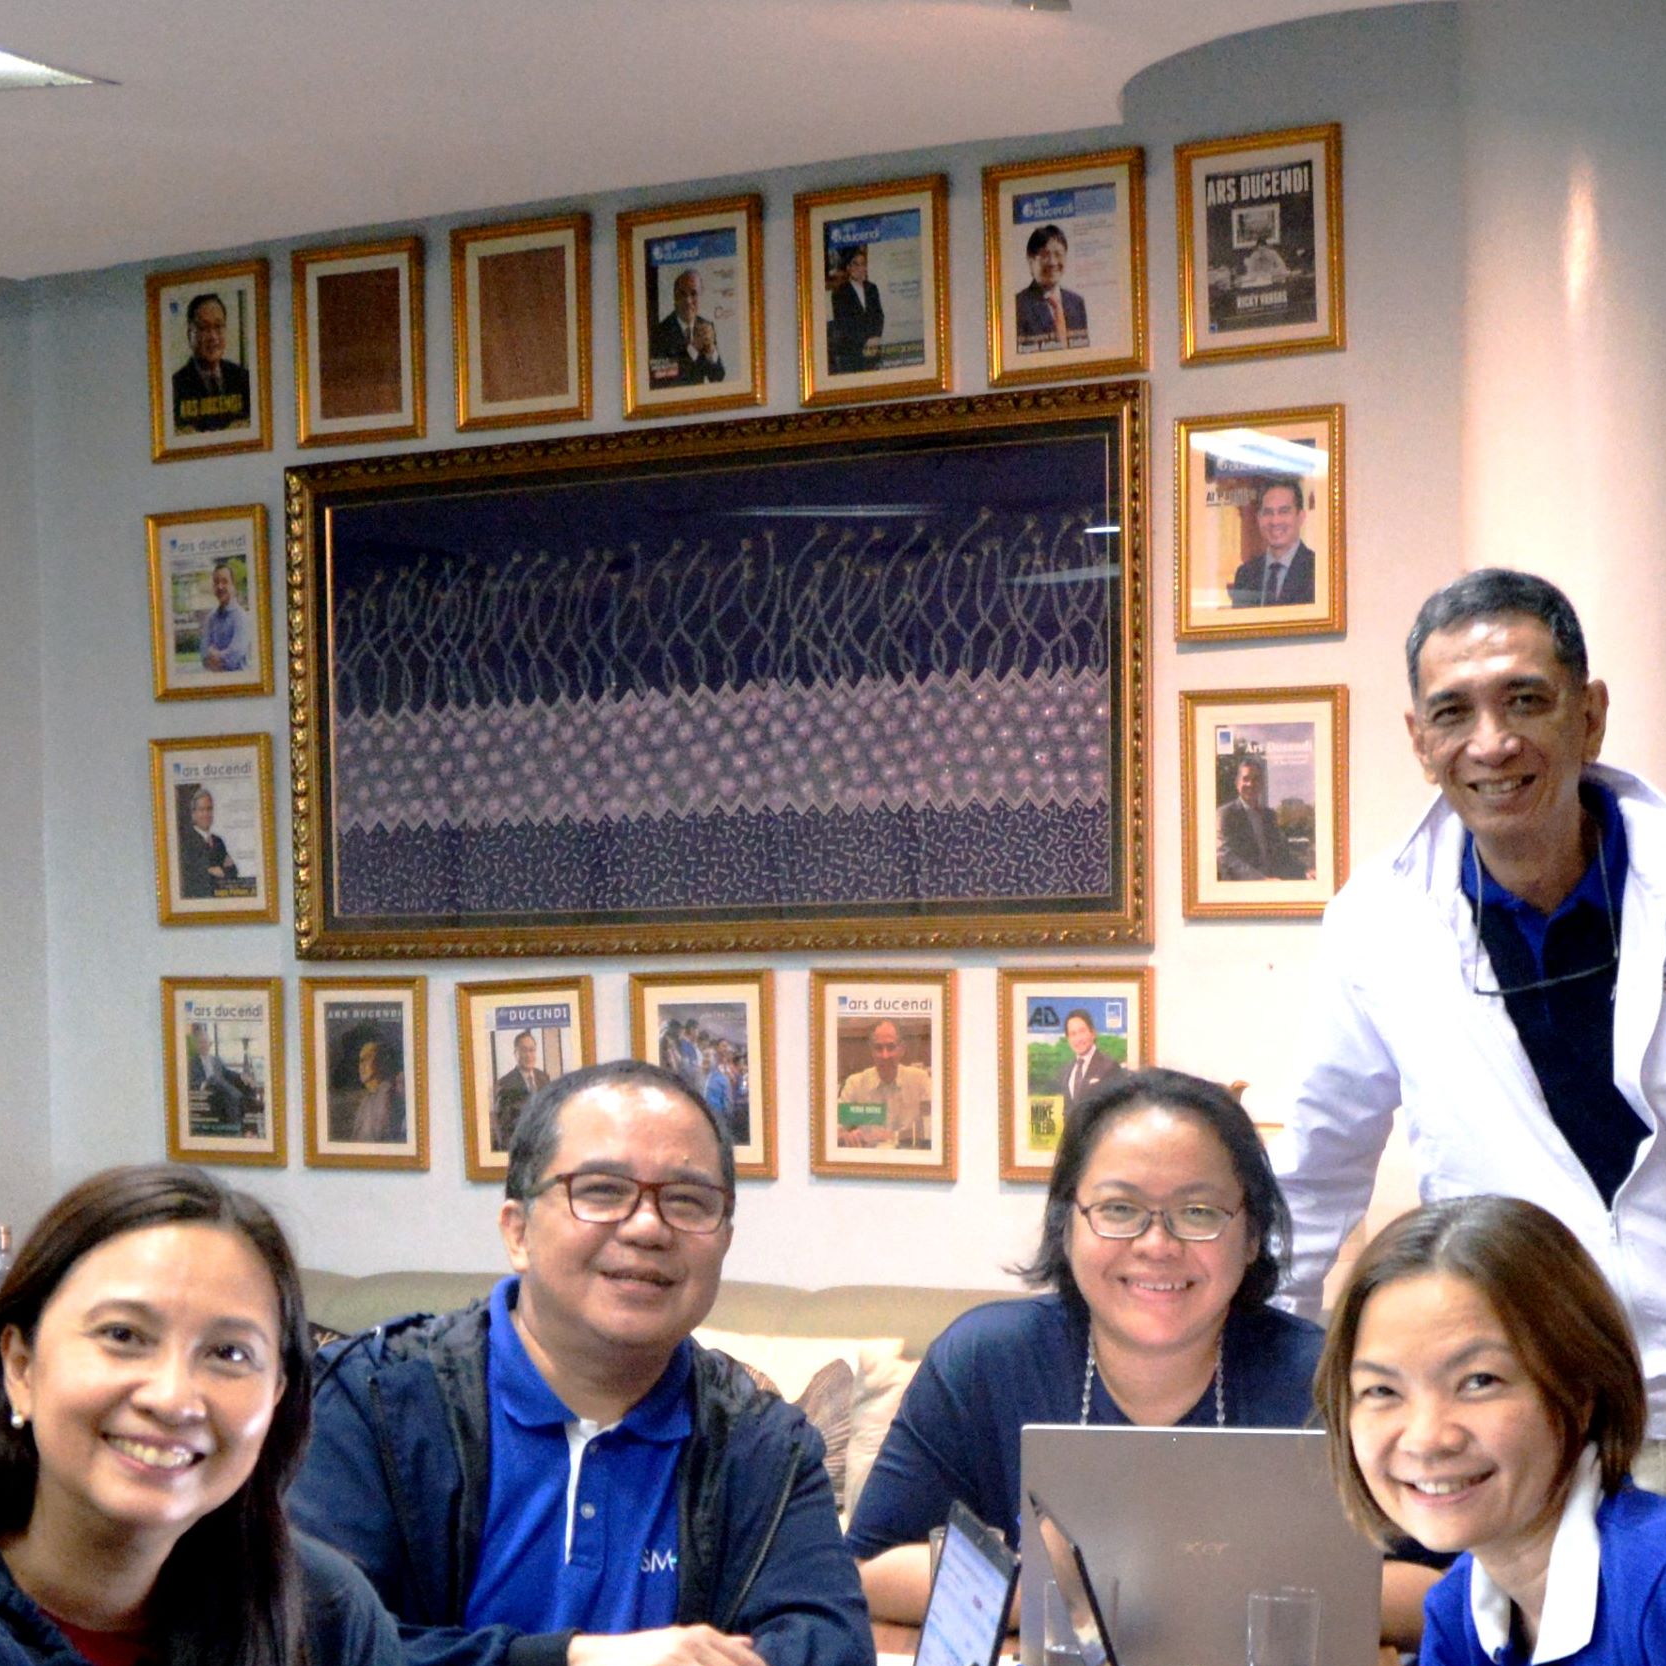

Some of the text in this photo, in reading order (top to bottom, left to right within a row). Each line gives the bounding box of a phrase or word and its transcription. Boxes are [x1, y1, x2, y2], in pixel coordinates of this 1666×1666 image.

[1207, 166, 1309, 206] ARS DUCENDI
[1245, 741, 1264, 754] Ars
[182, 762, 253, 777] ars ducendi
[193, 1003, 263, 1018] ars ducendi
[848, 997, 932, 1011] ars ducendi
[509, 1007, 568, 1021] DUCENDI
